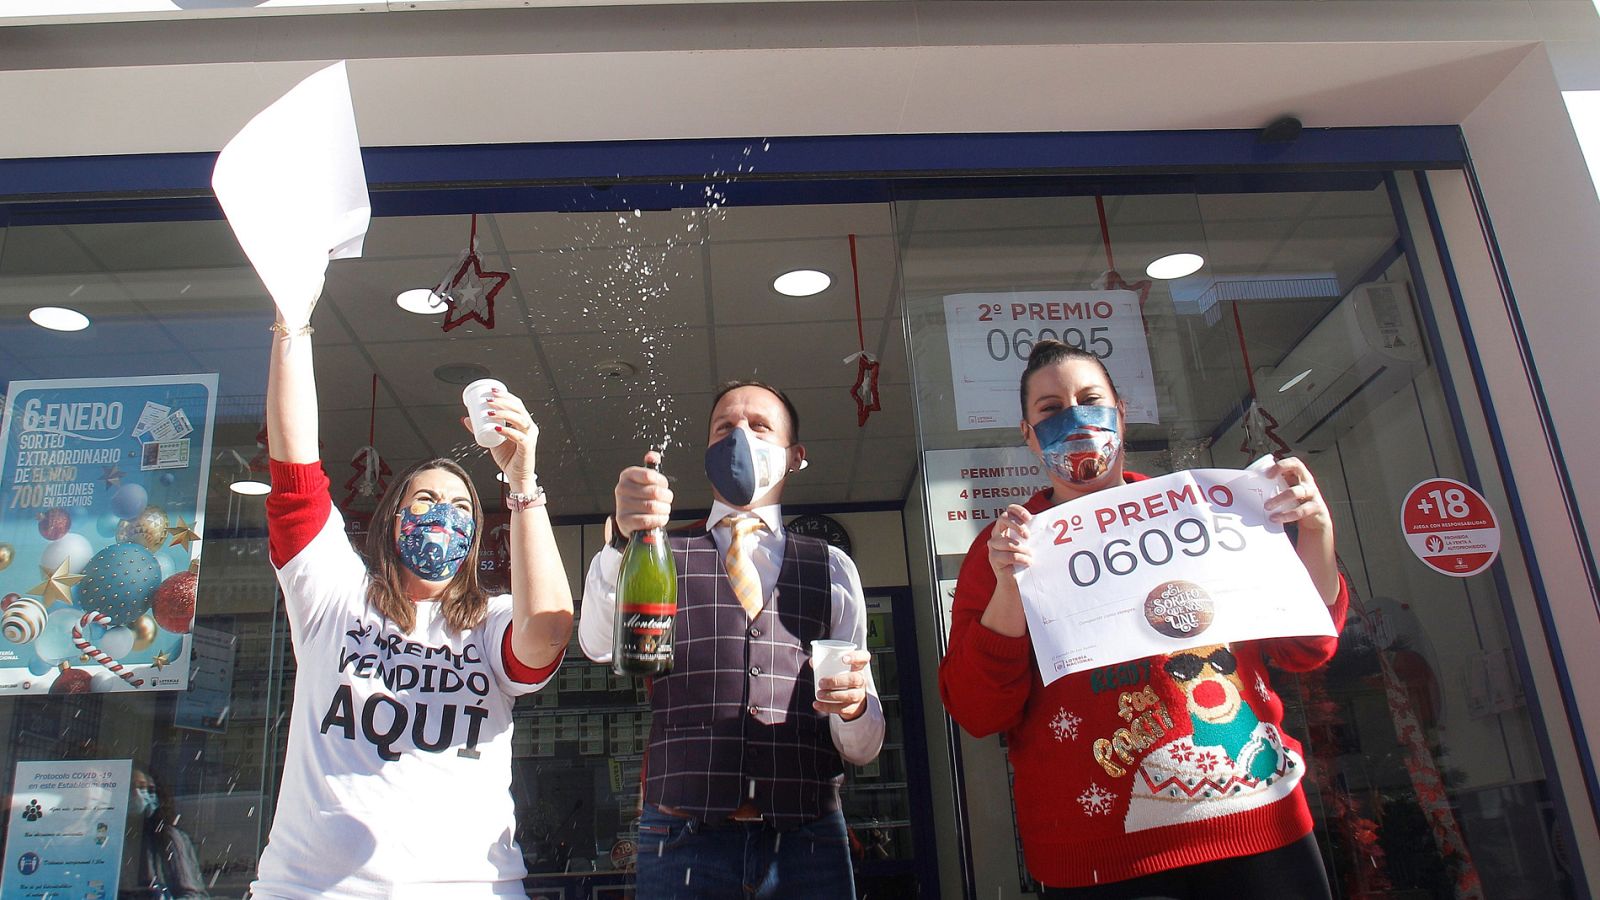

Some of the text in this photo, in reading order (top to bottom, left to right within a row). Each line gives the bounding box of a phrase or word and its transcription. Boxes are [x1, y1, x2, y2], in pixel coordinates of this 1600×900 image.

[977, 301, 1113, 321] 2º PREMIO
[23, 398, 41, 430] 6
[45, 401, 124, 431] ENERO
[20, 433, 66, 450] SORTEO
[17, 448, 121, 467] EXTRAORDINARIO
[14, 465, 77, 483] DE EL NIÑO
[960, 466, 1040, 479] PERMITIDO
[9, 482, 95, 509] 700 MILLONES
[42, 496, 93, 507] EN PREMIOS
[960, 489, 968, 499] 4
[1417, 488, 1470, 519] +18
[948, 511, 967, 521] EN
[972, 509, 990, 520] EL
[1051, 484, 1233, 545] 2º PREMIO
[807, 520, 819, 530] 12
[1441, 520, 1487, 528] RESPONSABILIDAD
[832, 532, 841, 541] 2
[1068, 513, 1247, 587] 06095
[480, 560, 495, 571] 52
[1153, 588, 1200, 616] SORTEO
[1164, 611, 1199, 632] UNE
[338, 646, 490, 697] VENDIDO
[320, 684, 489, 762] AQUÍ
[34, 772, 70, 780] Protocolo
